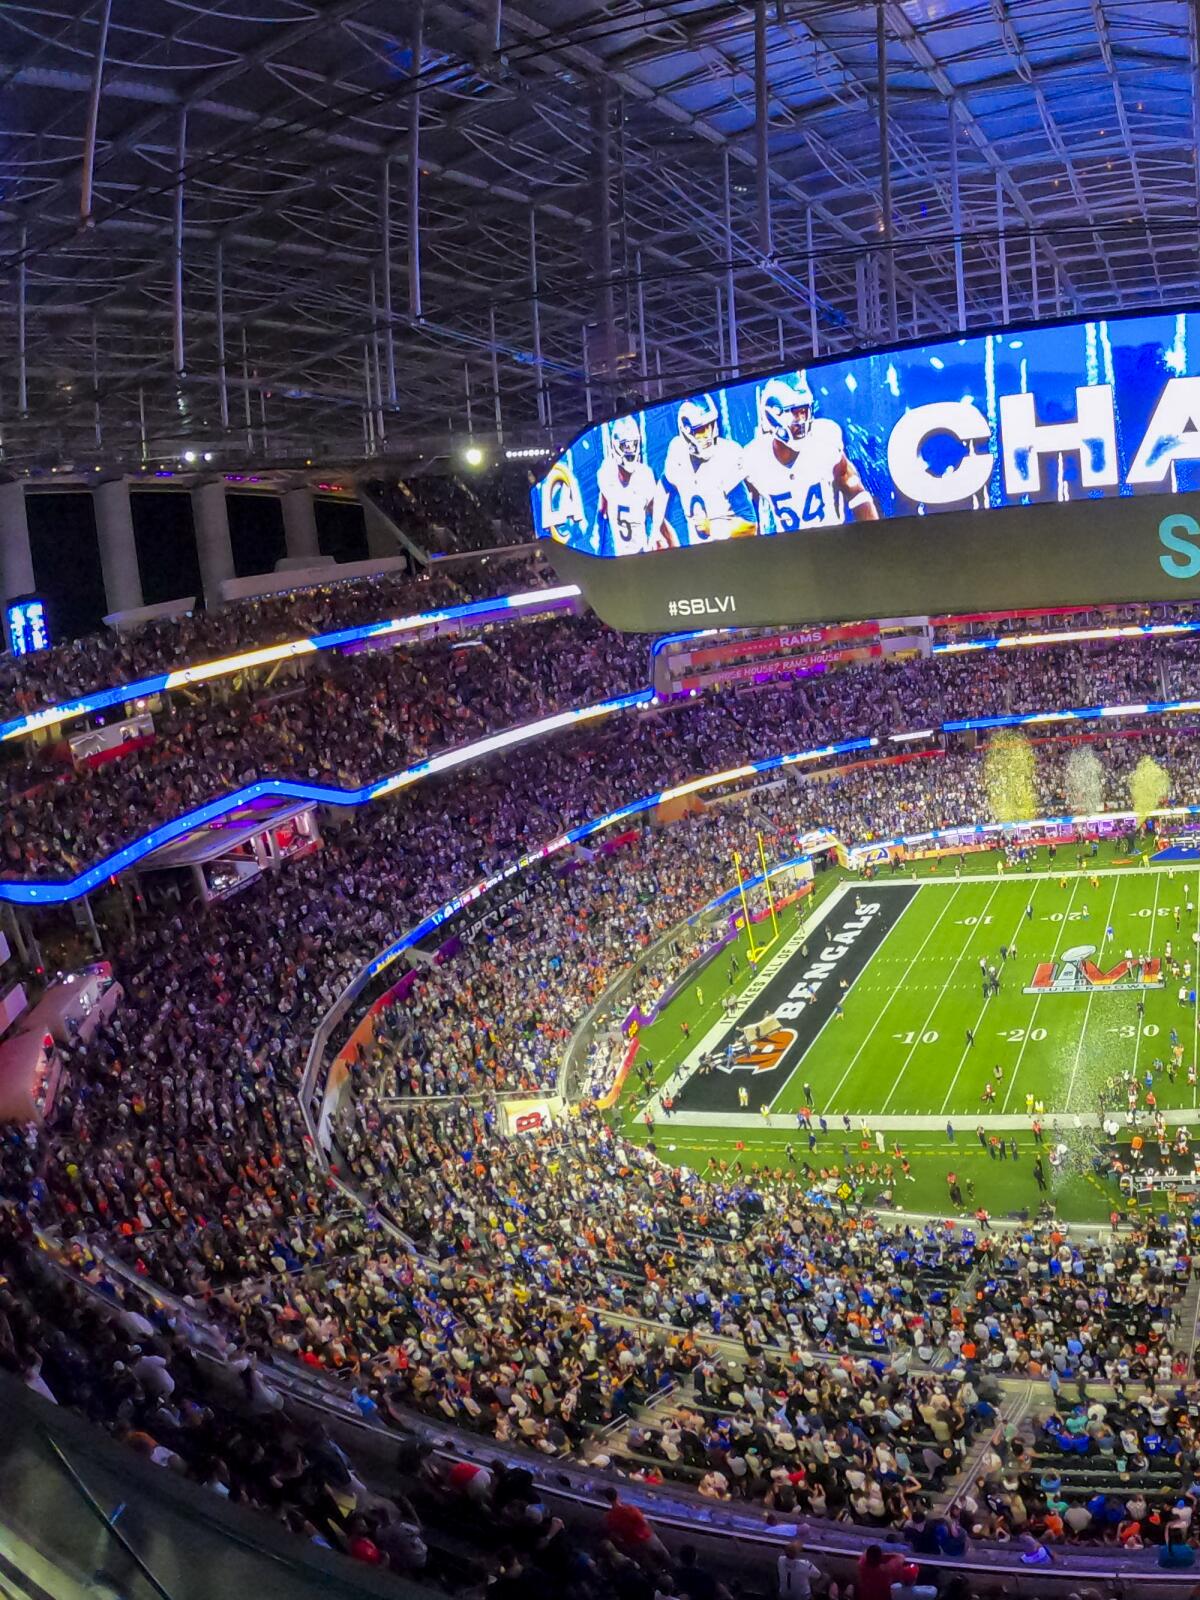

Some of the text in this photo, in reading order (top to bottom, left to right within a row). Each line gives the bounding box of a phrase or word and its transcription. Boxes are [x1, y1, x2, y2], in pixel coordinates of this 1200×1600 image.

[769, 482, 826, 532] 54
[616, 504, 632, 542] 5
[668, 596, 737, 616] #SBLVI
[779, 632, 822, 647] RAMS
[744, 663, 780, 677] HOUSE?
[810, 653, 843, 664] HOUSE!
[963, 915, 995, 926] 10
[1139, 907, 1171, 917] 30
[762, 964, 782, 982] ALL
[777, 949, 793, 964] OF
[774, 902, 882, 1020] BENGALS
[903, 1030, 939, 1044] 10
[1007, 1028, 1048, 1042] 20
[1118, 1024, 1160, 1038] 30
